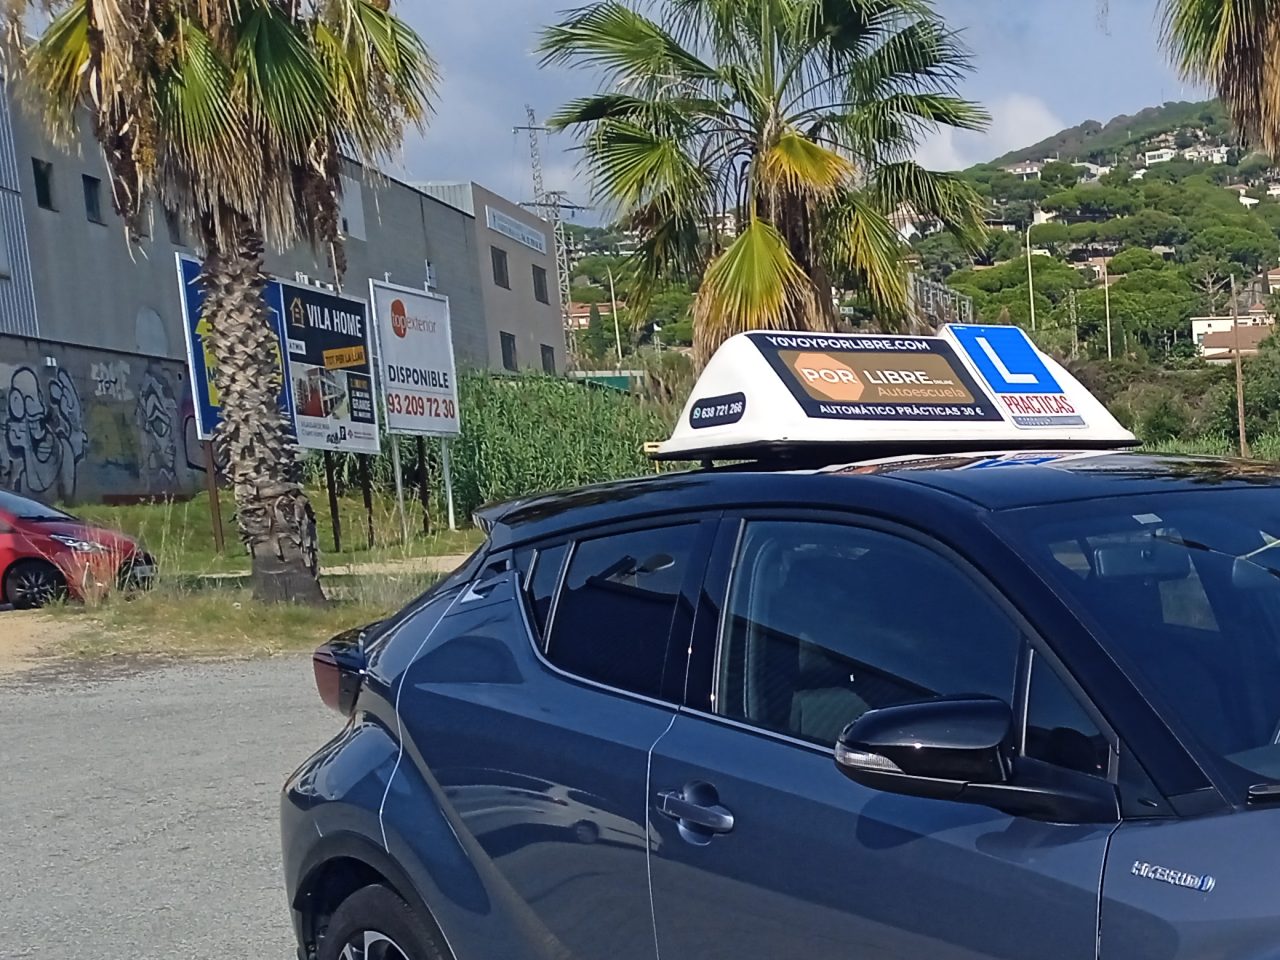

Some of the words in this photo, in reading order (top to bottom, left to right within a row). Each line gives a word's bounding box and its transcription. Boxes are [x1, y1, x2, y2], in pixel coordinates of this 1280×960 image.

[306, 303, 332, 331] VILA
[333, 309, 362, 338] HOME
[975, 336, 1040, 384] L
[388, 364, 449, 389] DISPONIBLE
[801, 368, 858, 385] POR
[863, 370, 934, 385] LIBRE
[878, 386, 966, 399] Autoescuela
[388, 393, 402, 415] 93
[404, 395, 425, 418] 209
[426, 397, 441, 418] 72
[441, 398, 455, 419] 30
[701, 406, 715, 419] 638
[716, 404, 729, 417] 721
[820, 404, 894, 417] AUTOMÁTICO
[895, 406, 962, 417] PRÁCTICAS
[963, 407, 975, 417] 30
[976, 406, 985, 417] €
[1001, 395, 1075, 415] PRACTICAS
